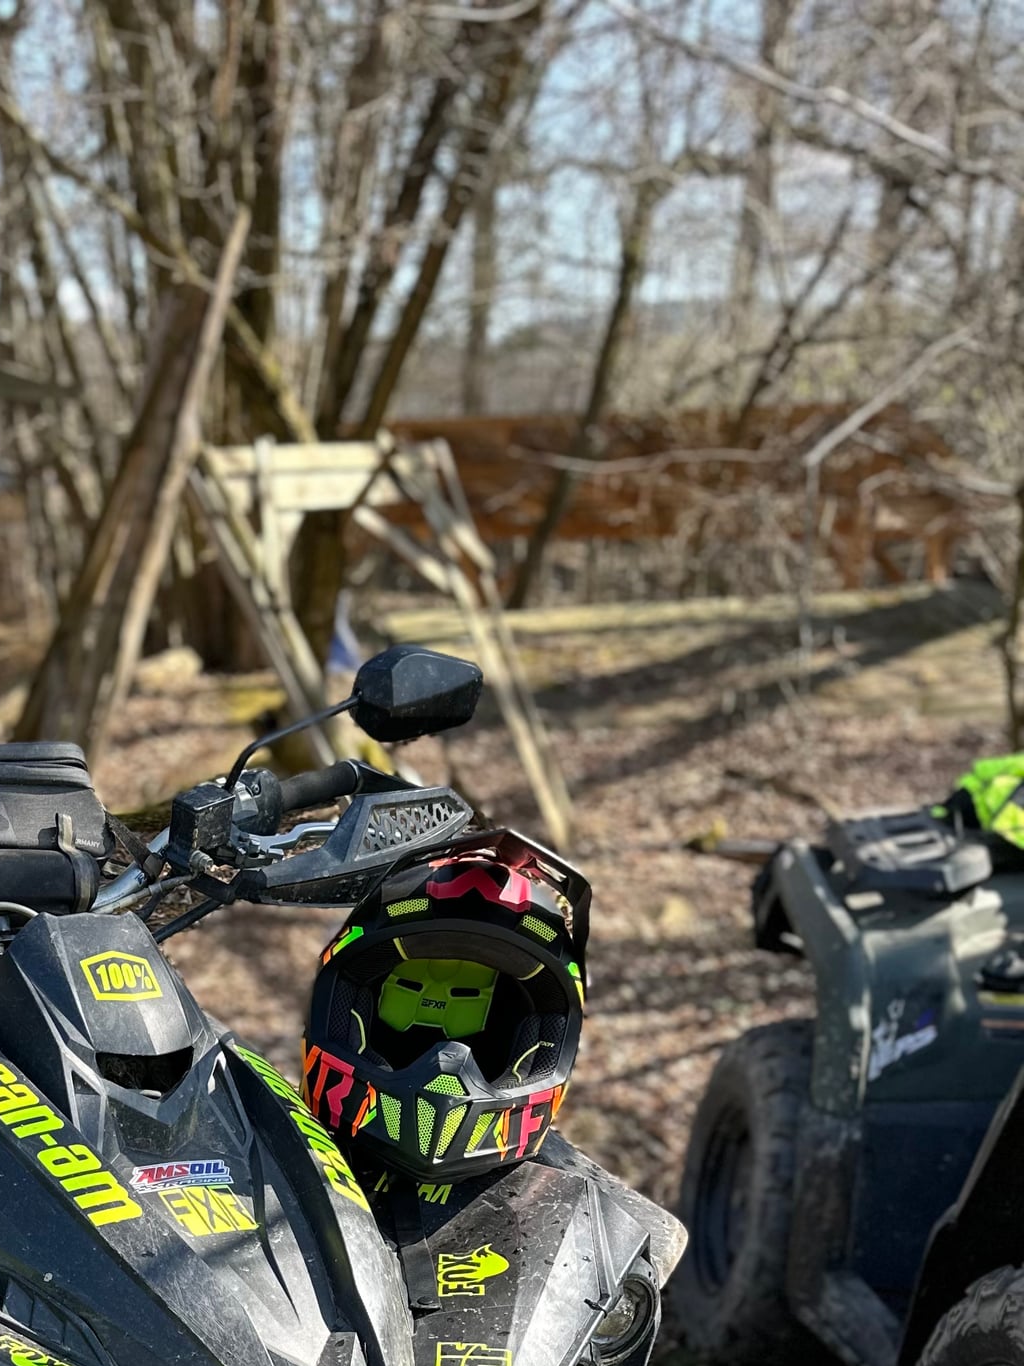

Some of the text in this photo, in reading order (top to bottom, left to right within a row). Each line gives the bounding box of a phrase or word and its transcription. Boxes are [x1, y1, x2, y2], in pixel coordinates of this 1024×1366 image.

[97, 963, 154, 991] 100%
[137, 1162, 225, 1184] AMSOIL
[159, 1185, 258, 1236] FXR
[437, 1248, 499, 1297] FOX
